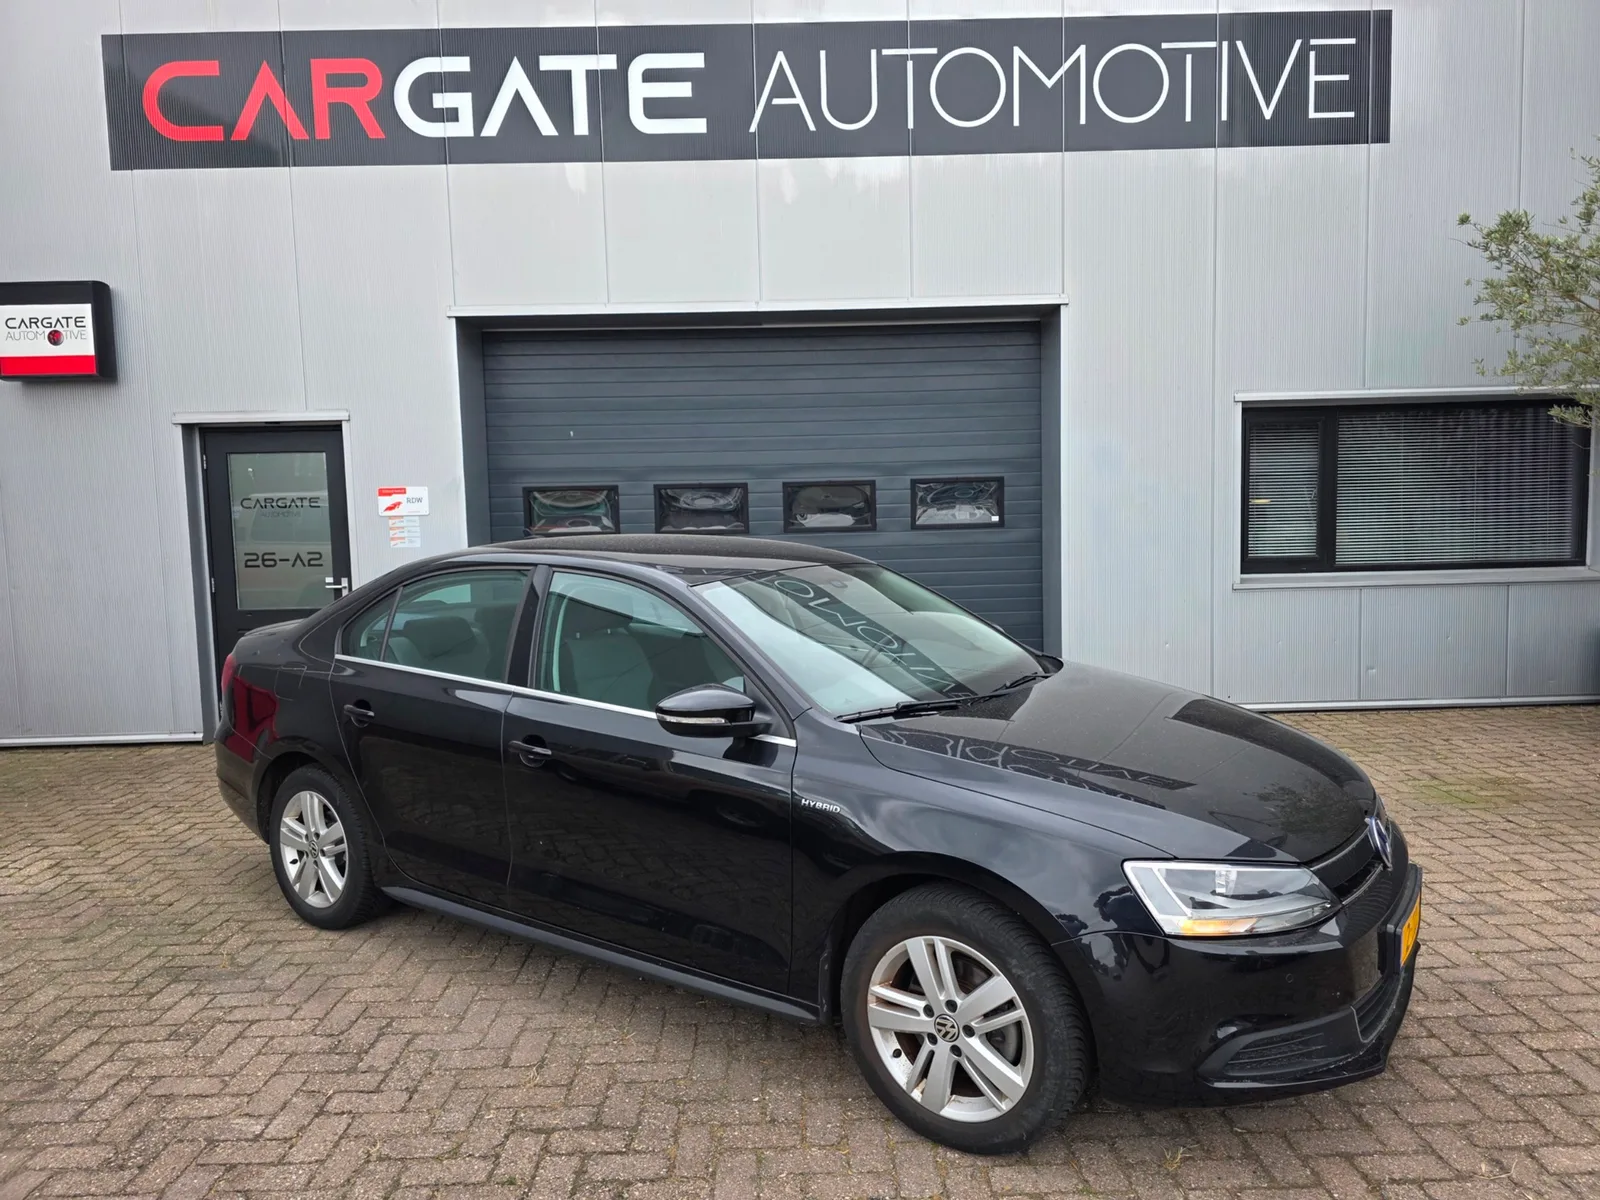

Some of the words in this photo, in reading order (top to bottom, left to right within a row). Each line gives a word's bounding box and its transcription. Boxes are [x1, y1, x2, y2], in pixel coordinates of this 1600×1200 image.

[142, 52, 708, 142] CARGATE
[748, 37, 1357, 133] AUTOMOTIVE
[5, 316, 87, 330] CARGATE
[240, 497, 321, 509] CARGATE
[244, 552, 323, 568] 26-A2
[801, 798, 841, 814] HYBRID
